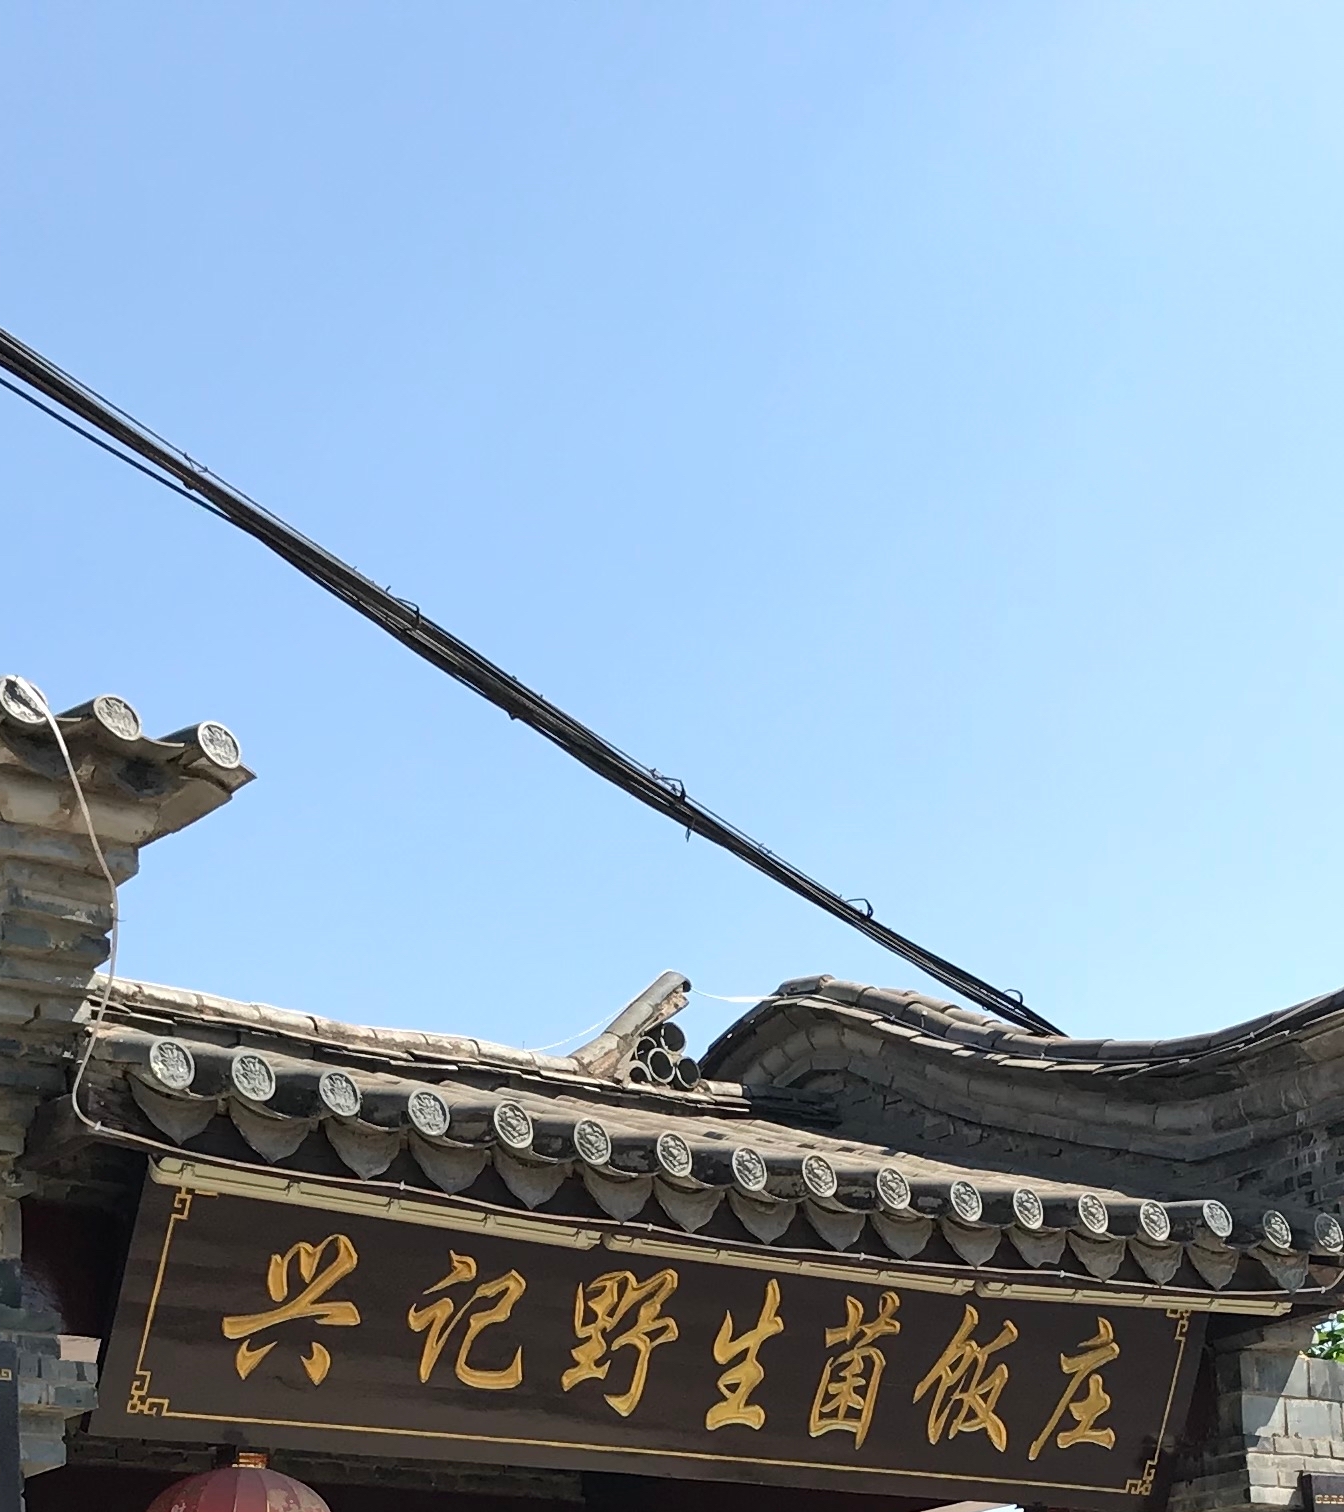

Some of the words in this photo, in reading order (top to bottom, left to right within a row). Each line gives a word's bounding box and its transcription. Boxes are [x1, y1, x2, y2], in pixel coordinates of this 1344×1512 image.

[220, 1232, 1120, 1462] 兴记野生菌饭庄
